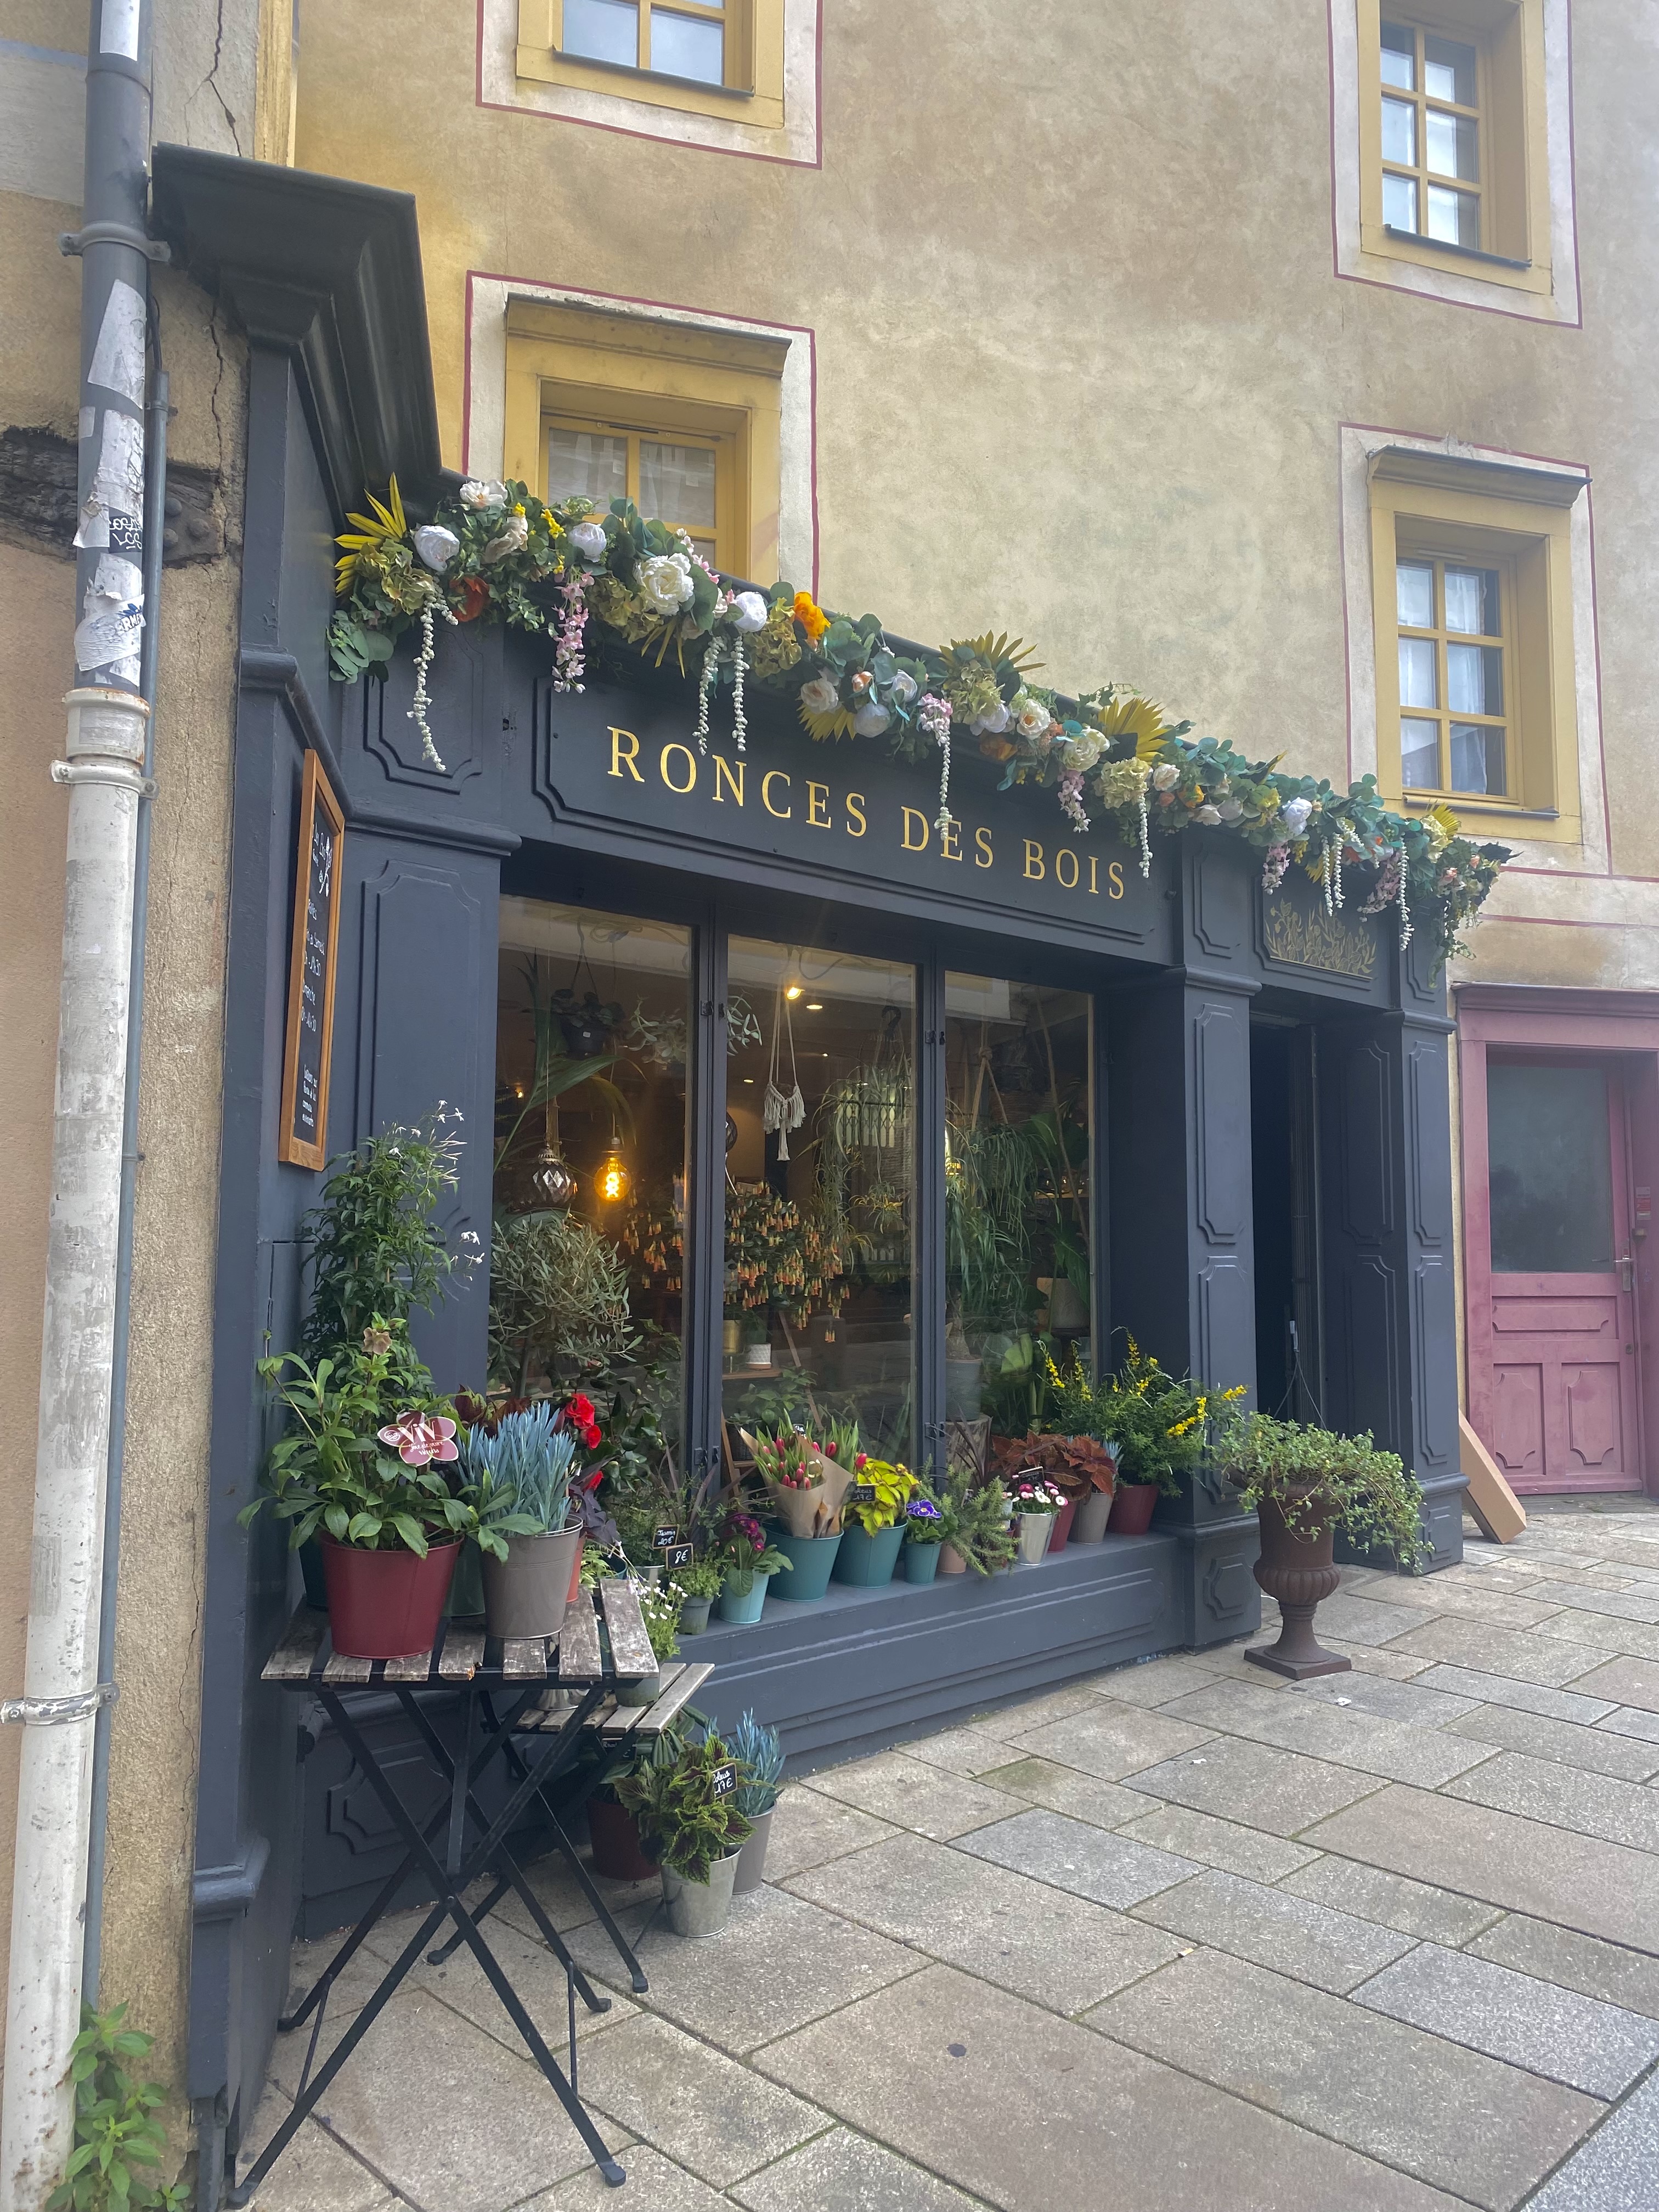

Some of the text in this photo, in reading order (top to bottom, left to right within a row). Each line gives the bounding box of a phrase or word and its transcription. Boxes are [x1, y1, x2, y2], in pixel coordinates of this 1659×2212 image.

[606, 726, 1125, 900] RONCES DES BOIS
[658, 1536, 674, 1545] 20€
[714, 1778, 733, 1793] 17€
